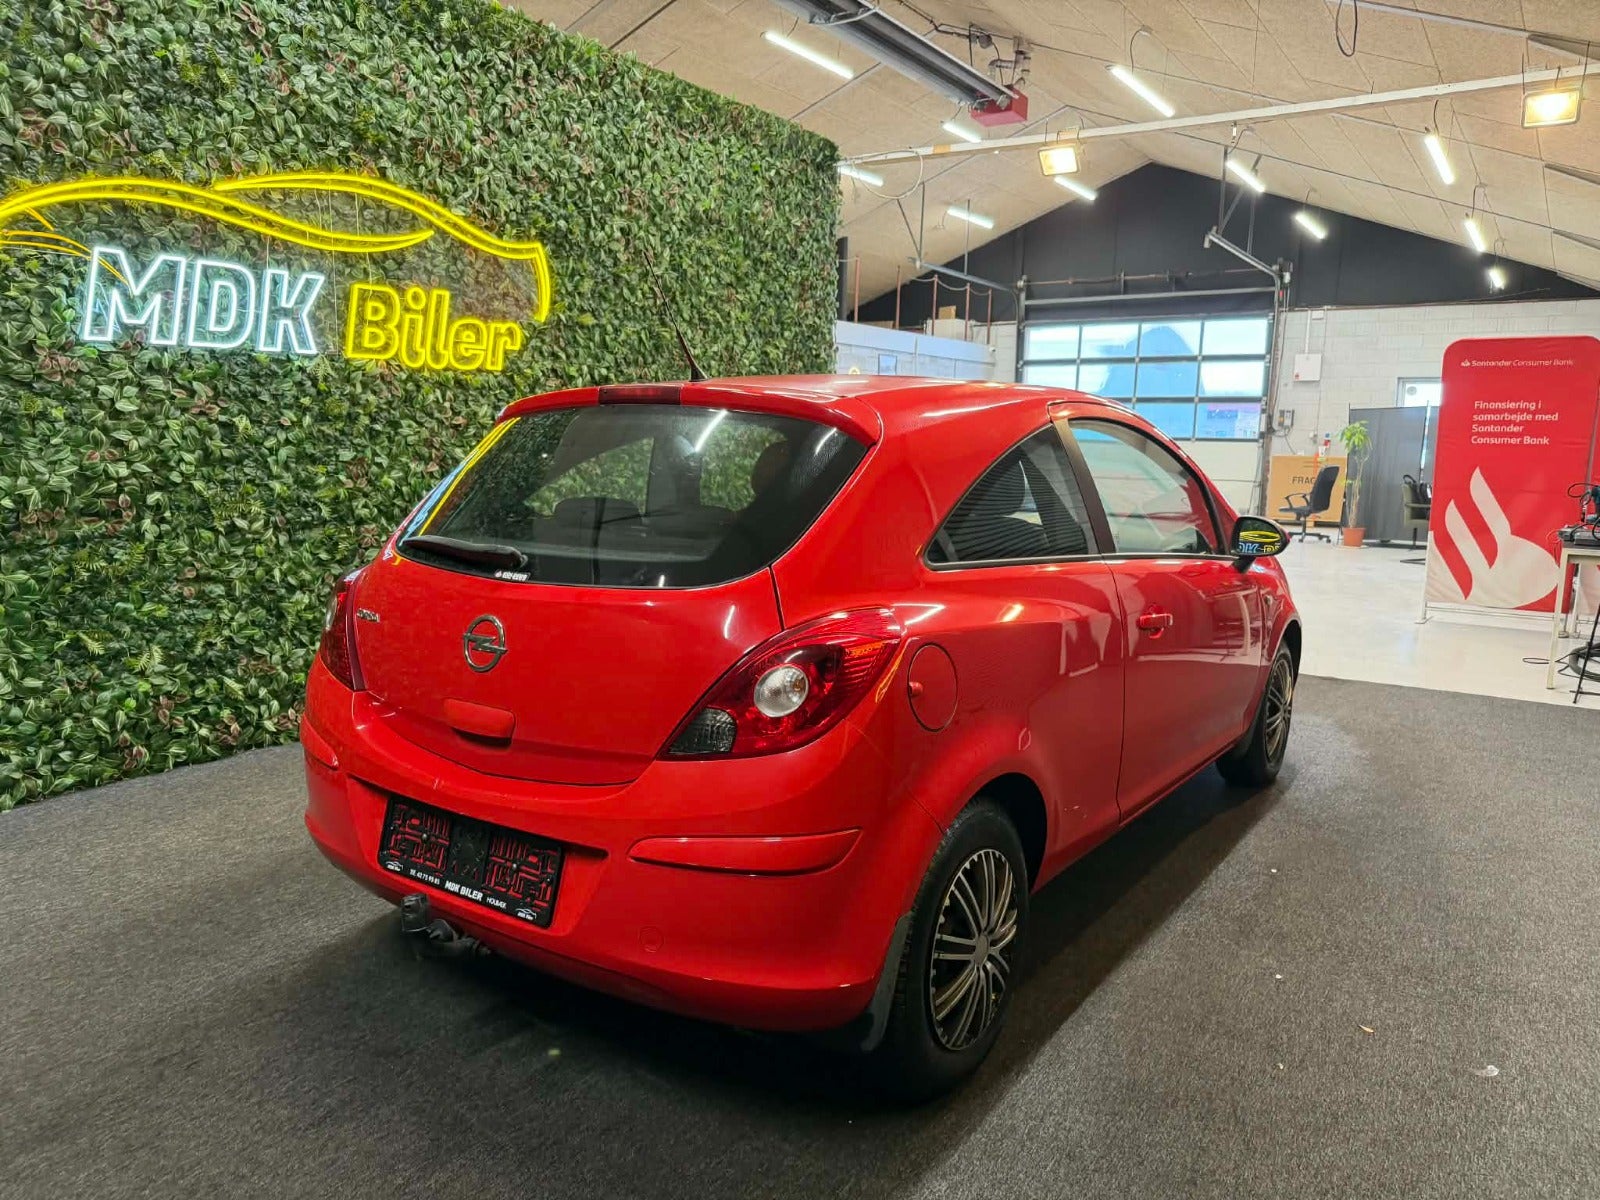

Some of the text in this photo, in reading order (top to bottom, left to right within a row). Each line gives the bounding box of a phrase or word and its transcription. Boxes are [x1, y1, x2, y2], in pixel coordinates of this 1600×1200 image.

[82, 245, 522, 371] MDK Biler
[1471, 359, 1512, 367] Santander
[1512, 359, 1552, 367] Consumer
[1474, 400, 1536, 411] Finansiering
[1472, 412, 1559, 422] samarbejde med
[1471, 424, 1524, 433] Santander
[1471, 435, 1550, 445] Consumer Bank
[444, 880, 461, 893] MDK
[460, 886, 484, 902] BILER
